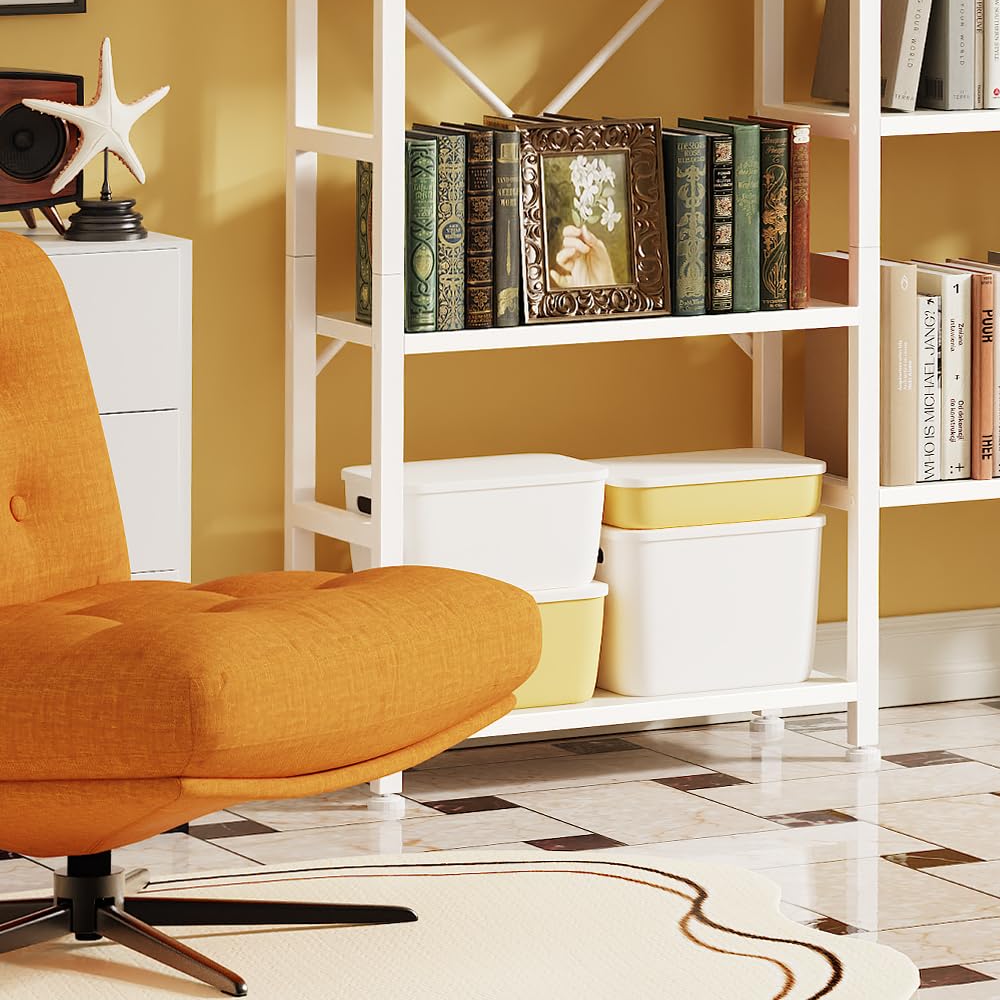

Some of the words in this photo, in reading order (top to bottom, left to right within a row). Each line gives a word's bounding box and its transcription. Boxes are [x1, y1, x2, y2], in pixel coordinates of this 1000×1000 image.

[913, 8, 922, 32] YOUR
[906, 38, 917, 69] WORLD
[952, 283, 960, 294] 1
[923, 310, 936, 356] JANG?
[957, 322, 965, 347] Zmiana
[923, 357, 936, 422] MICHAEL
[949, 398, 956, 406] do
[957, 400, 965, 410] Od
[923, 426, 936, 438] IS
[949, 407, 957, 443] konstrukcji
[957, 410, 965, 441] dekoracji
[923, 442, 936, 480] WHO
